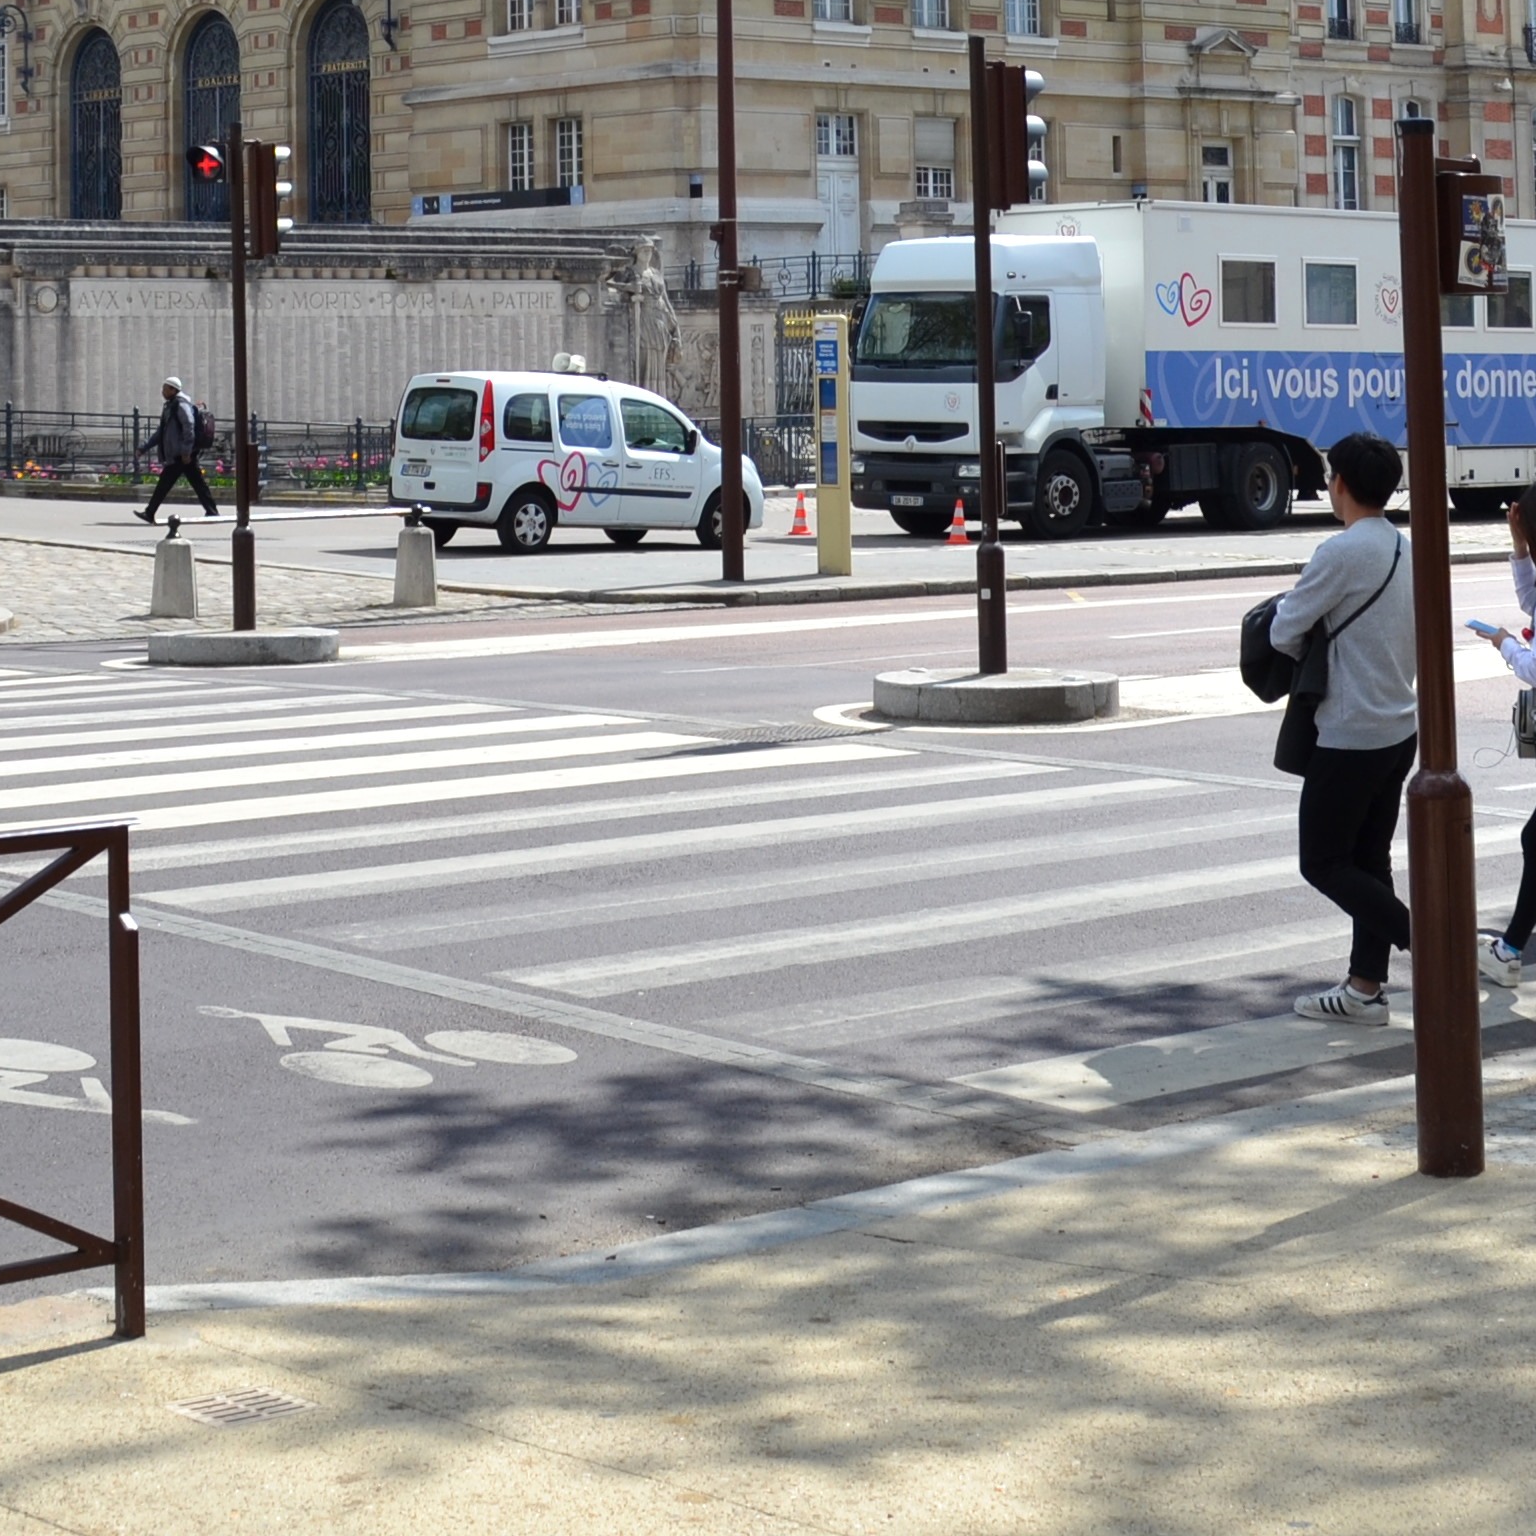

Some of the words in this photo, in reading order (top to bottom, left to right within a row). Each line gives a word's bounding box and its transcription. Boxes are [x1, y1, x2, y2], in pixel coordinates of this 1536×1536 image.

[292, 291, 362, 310] MORTS
[380, 291, 433, 310] POVR
[451, 291, 473, 310] LA
[492, 291, 556, 310] PATRIE
[1215, 357, 1258, 407] Ici,
[1266, 368, 1339, 399] vous
